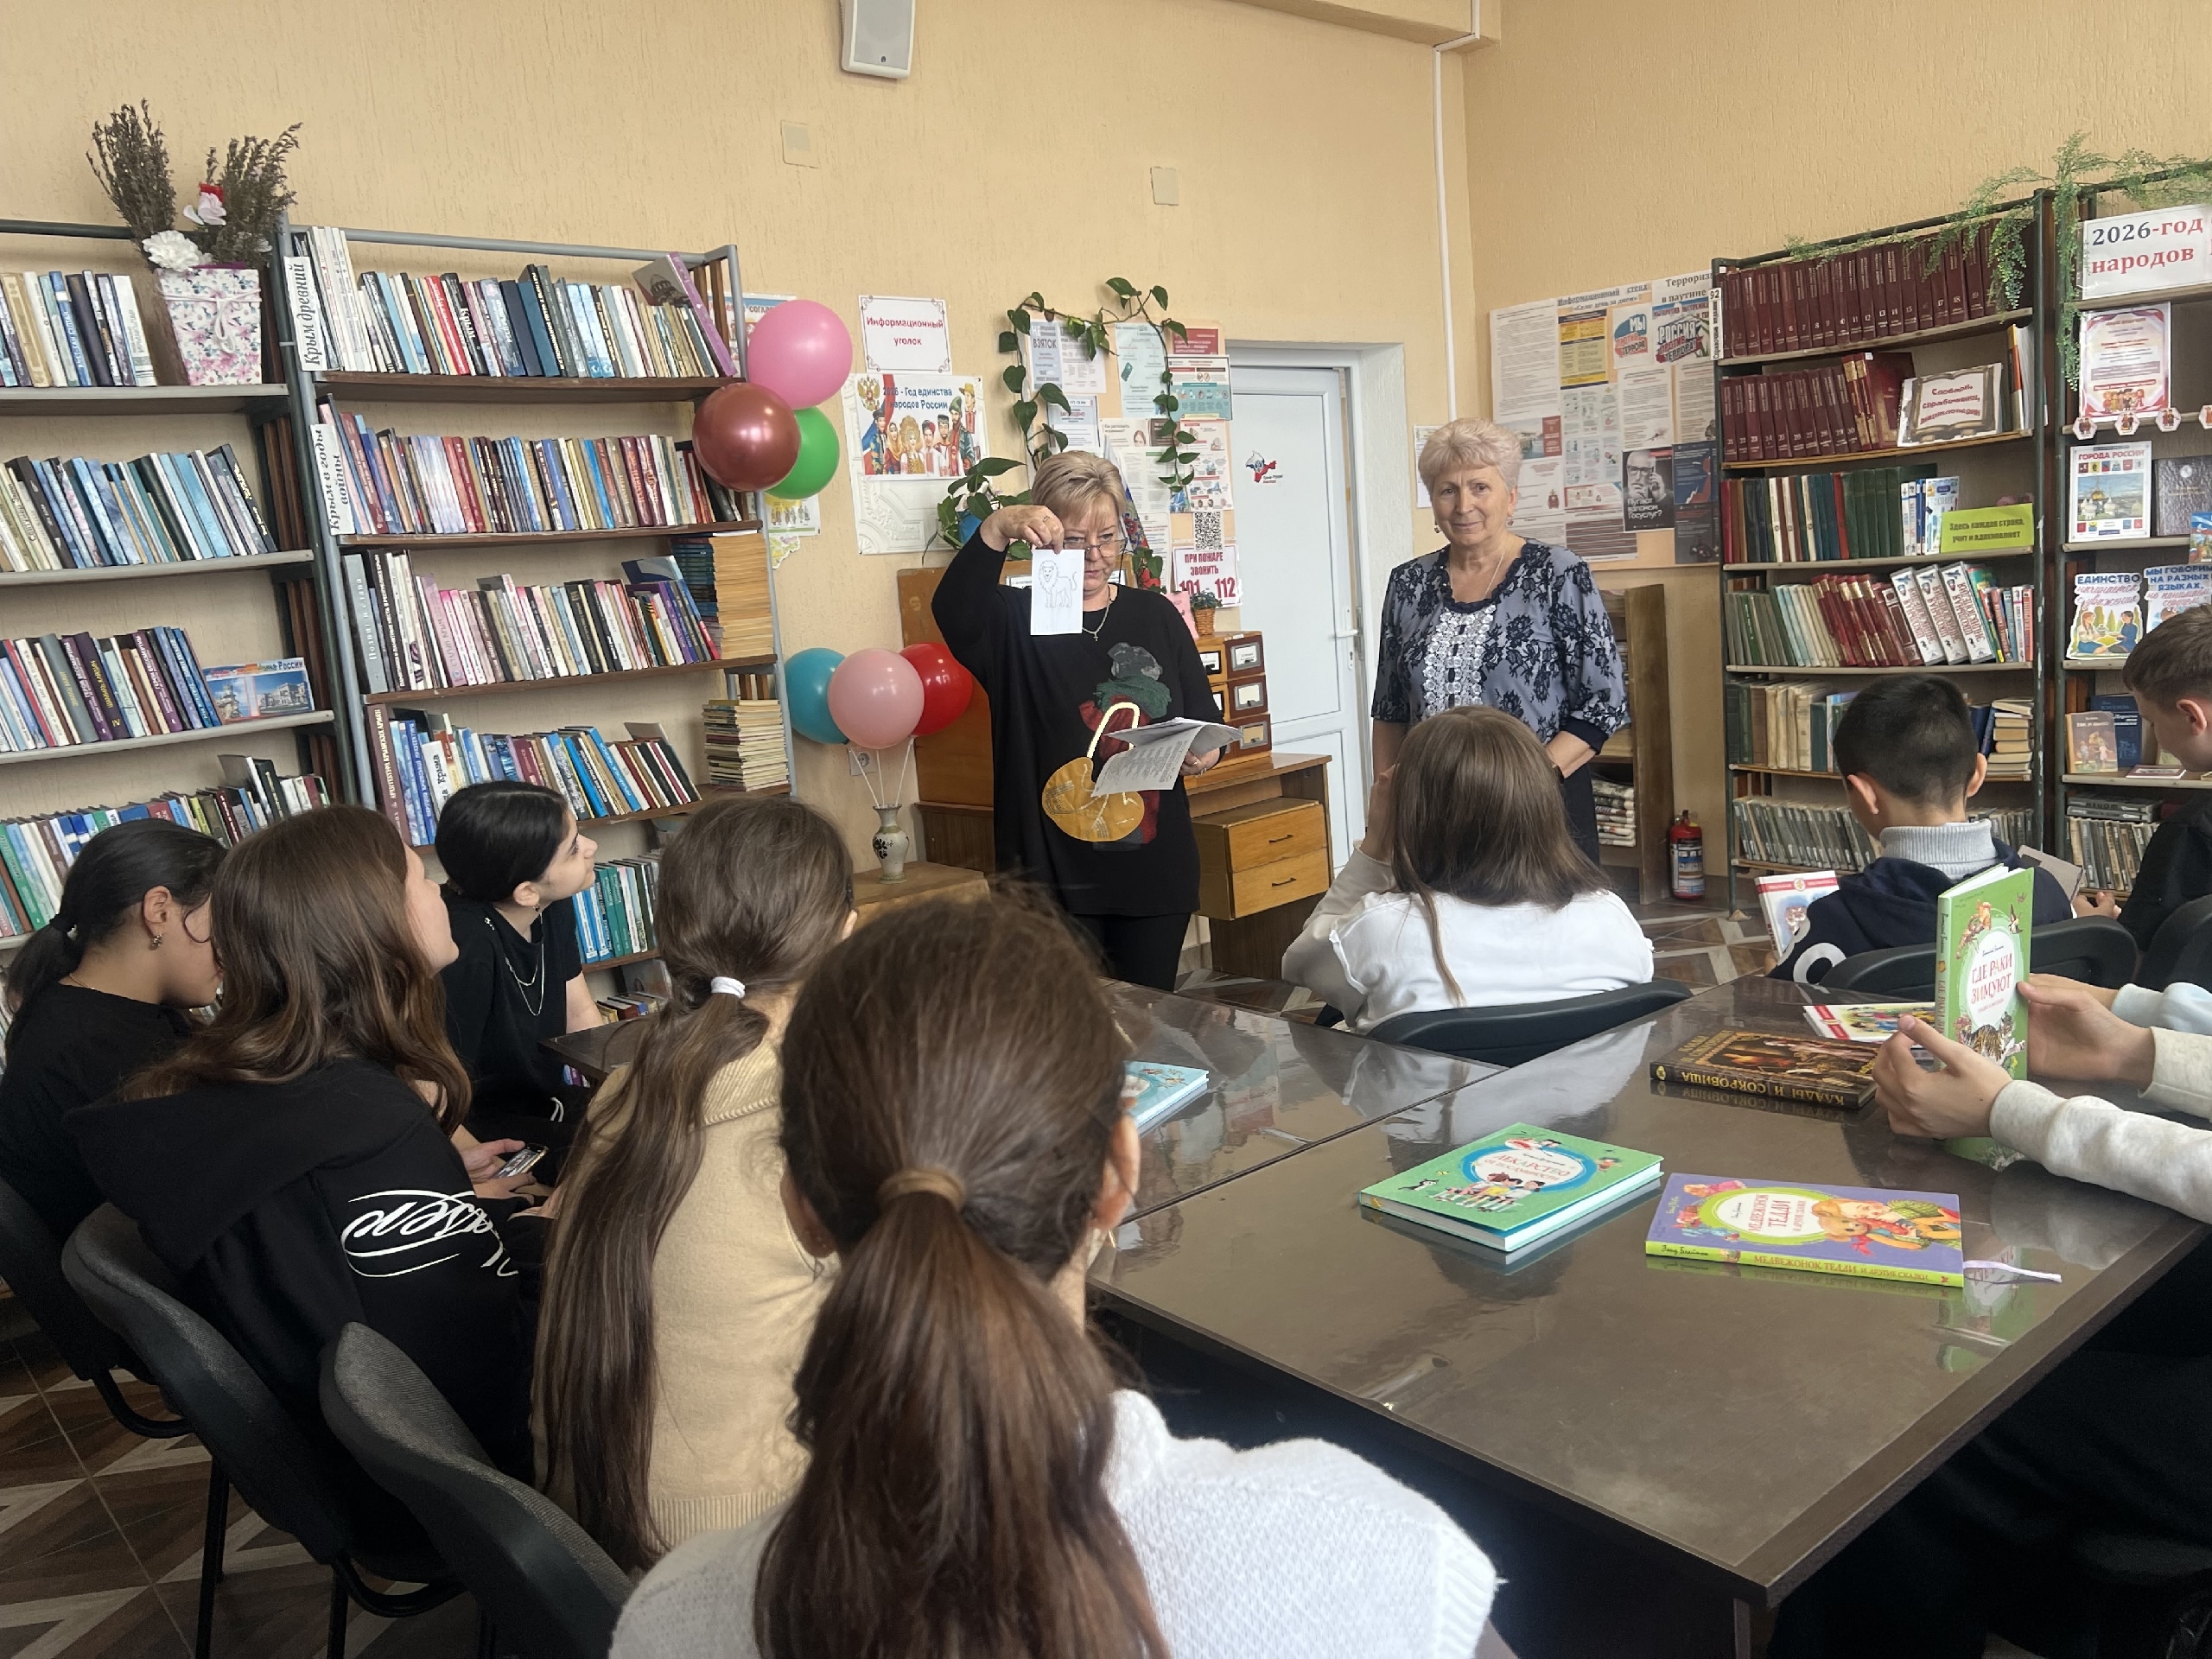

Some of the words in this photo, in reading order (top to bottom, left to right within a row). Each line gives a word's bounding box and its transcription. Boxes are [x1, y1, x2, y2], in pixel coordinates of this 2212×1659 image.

[2092, 247, 2194, 275] народов
[1665, 272, 1713, 288] Террориз
[289, 264, 315, 321] древний
[1710, 289, 1719, 300] 92
[1905, 305, 1913, 314] 15
[457, 306, 475, 339] Крым
[866, 316, 944, 329] Информационный
[1630, 316, 1646, 332] МЫ
[1658, 321, 1698, 345] РОССИЯ
[304, 324, 322, 365] Крым
[893, 337, 922, 346] уголок
[1033, 339, 1057, 349] ВЗЯТОК
[906, 387, 917, 397] Год
[918, 388, 952, 397] единства
[921, 401, 948, 410] России
[315, 429, 328, 469] годы
[323, 472, 331, 481] в
[333, 454, 349, 505] войны
[326, 485, 340, 531] Крым
[1185, 553, 1198, 563] ПРИ
[1198, 552, 1224, 562] ПОЖАРЕ
[1191, 565, 1219, 576] ЗВОНИТЬ
[2077, 575, 2140, 584] ЕДИНСТВО
[2165, 565, 2212, 574] ГОВОРИМ
[355, 577, 366, 607] слава
[1215, 577, 1236, 599] 112
[384, 607, 392, 623] МЕСТА
[387, 624, 398, 652] ПАМЯТНЫЕ
[437, 619, 448, 638] КРЫМ
[363, 624, 377, 660] Подвиг
[393, 656, 405, 686] ПАМЯТНИКИ
[374, 709, 384, 728] АРМЯН
[378, 729, 389, 761] КРЫМСКИХ
[384, 761, 396, 798] АРХИТЕКТУРА
[436, 753, 450, 787] Крыма
[1972, 966, 1987, 984] ГДЕ
[1989, 952, 2012, 978] РАКИ
[1971, 973, 2012, 1004] ЗИМУЮТ
[1681, 1071, 1767, 1093] СОКРОВИЩА
[1774, 1084, 1784, 1096] И
[1791, 1089, 1845, 1106] КЛАДЫ
[1493, 1155, 1570, 1176] ЛЕКАРСТВО
[1746, 1193, 1769, 1233] МЕДВЕЖОНОК
[1768, 1199, 1791, 1228] ТЕДДИ
[1661, 1245, 1677, 1255] Энид
[1753, 1255, 1822, 1271] МЕДВЕЖОНОК
[1825, 1261, 1857, 1274] ТЕДДИ
[1897, 1271, 1929, 1282] СКАЗКИ
